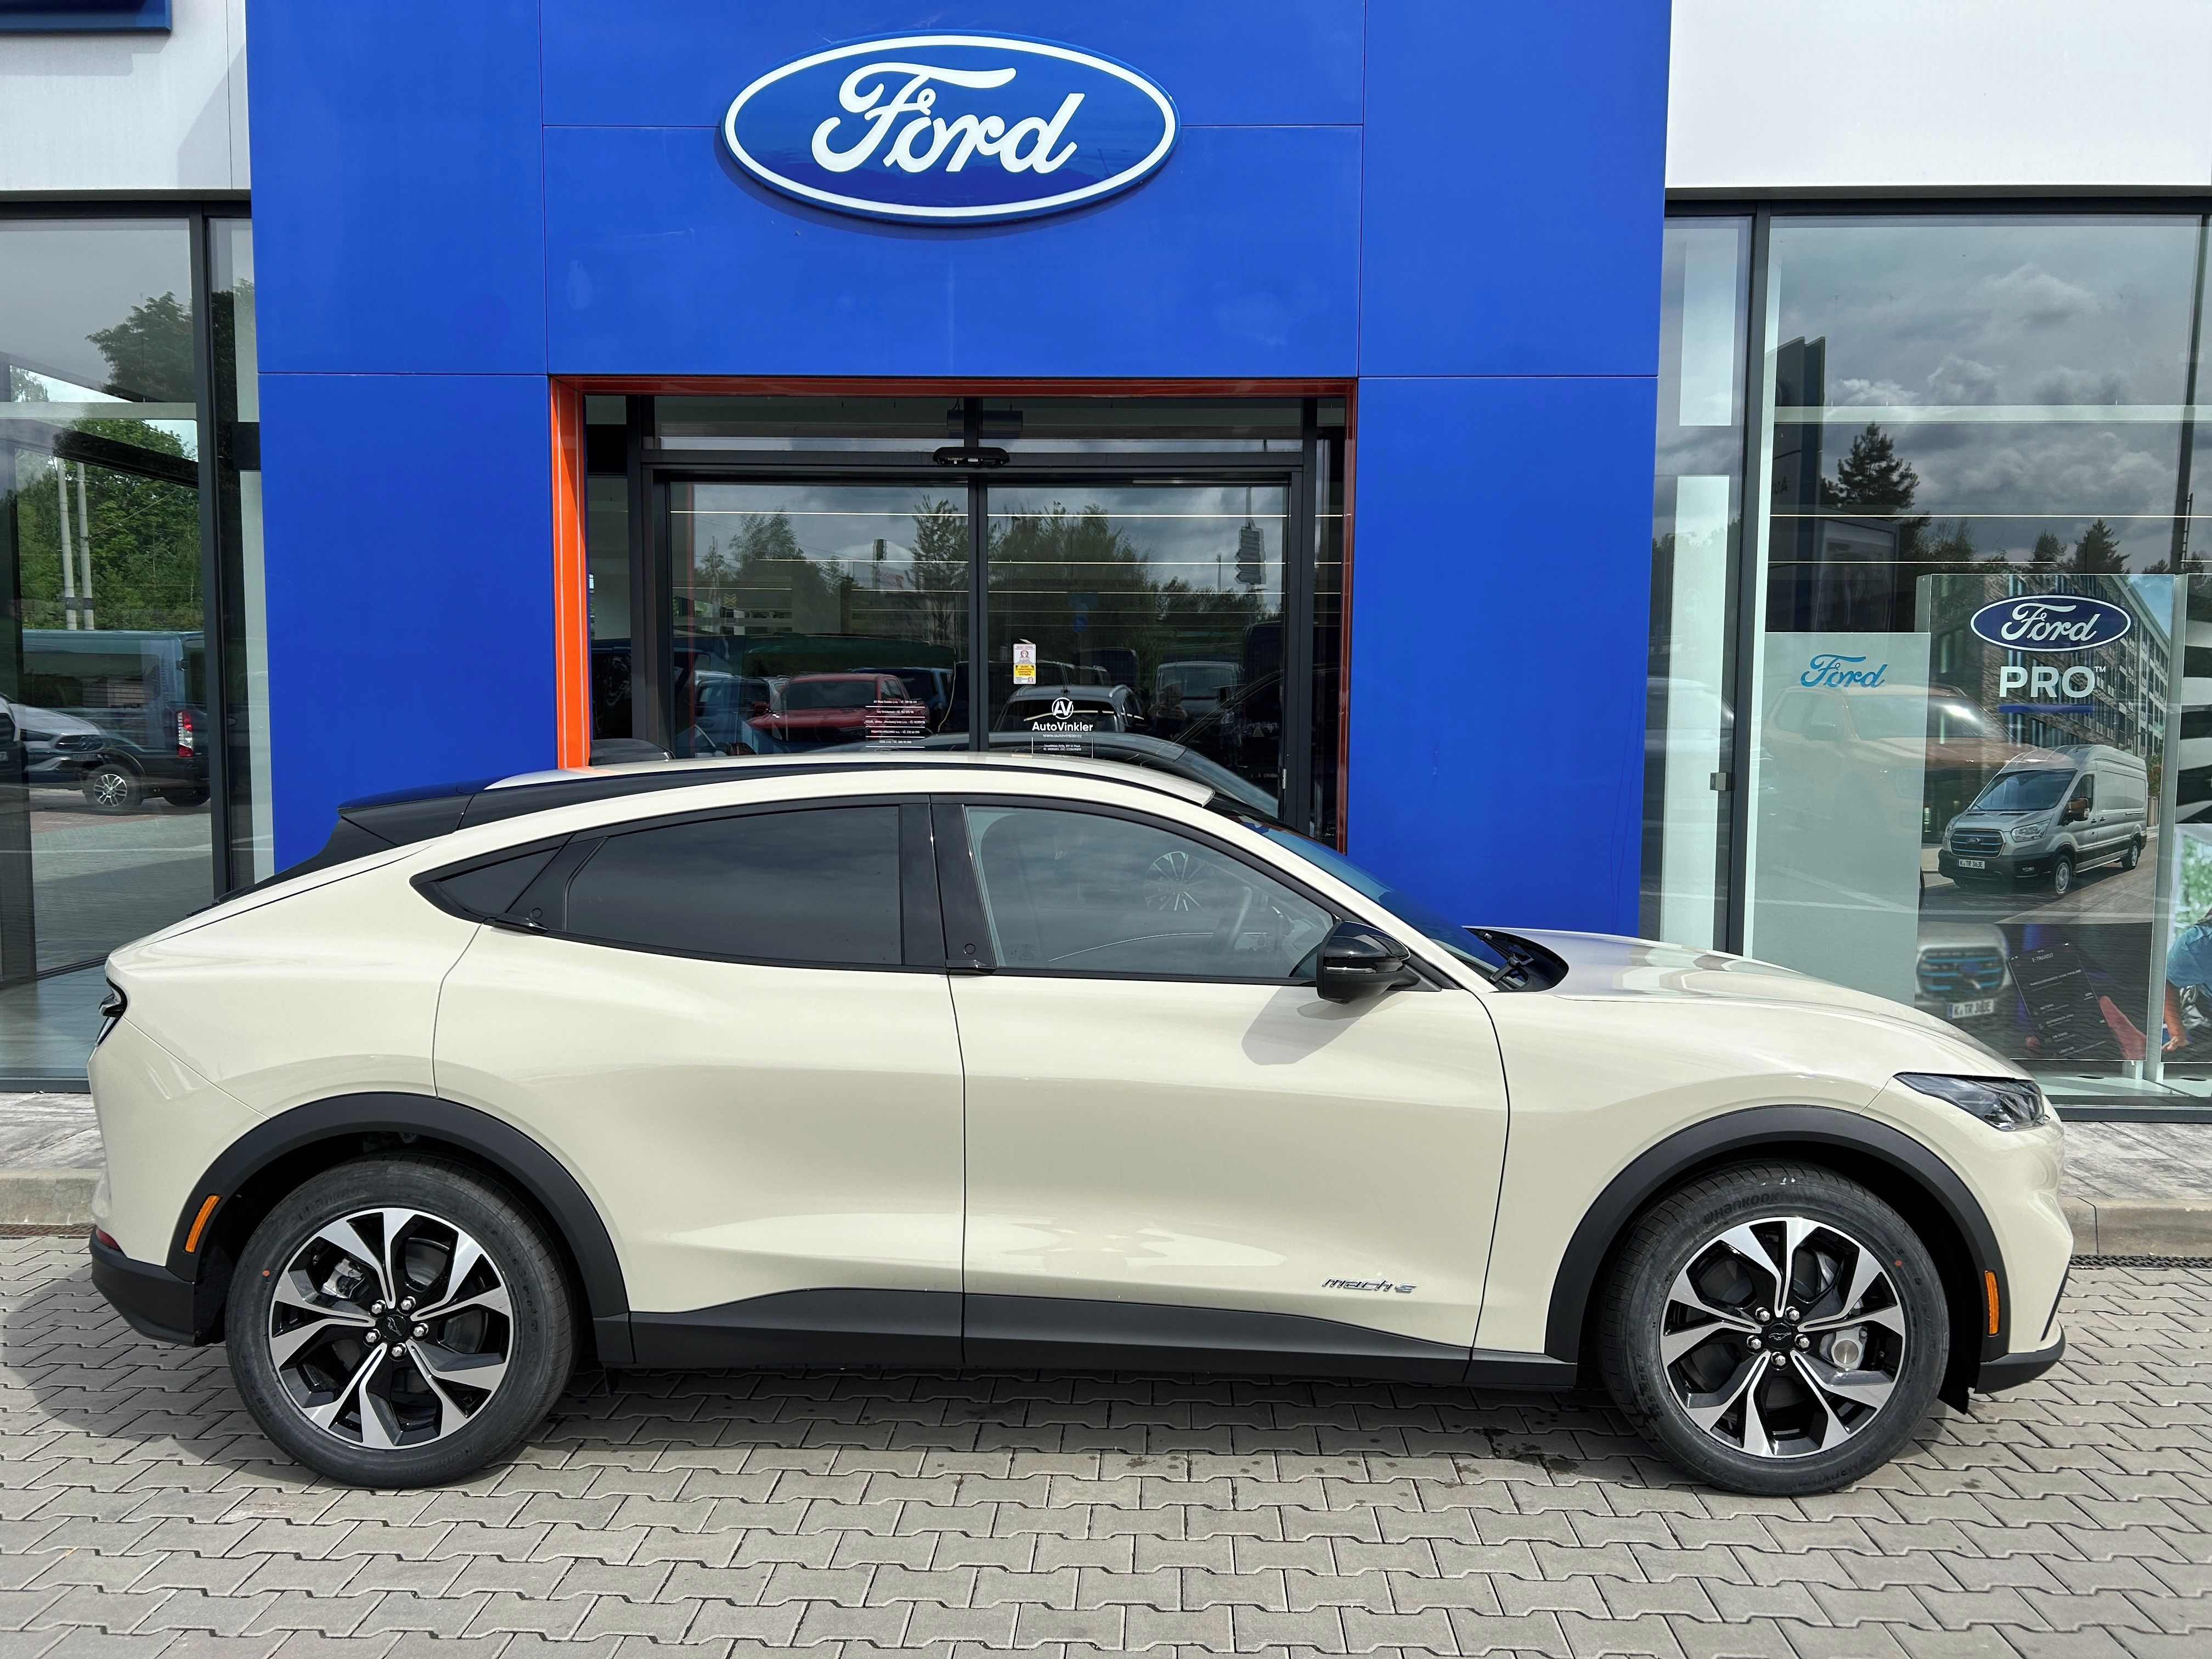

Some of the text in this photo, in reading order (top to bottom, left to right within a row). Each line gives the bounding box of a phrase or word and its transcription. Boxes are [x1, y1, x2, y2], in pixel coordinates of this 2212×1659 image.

[811, 62, 1086, 174] Ford
[2001, 602, 2102, 641] Ford
[1800, 654, 1888, 688] Ford
[1999, 665, 2096, 698] PRO
[1031, 721, 1093, 731] AutoVinkler
[2032, 952, 2054, 962] E-TRANSIT
